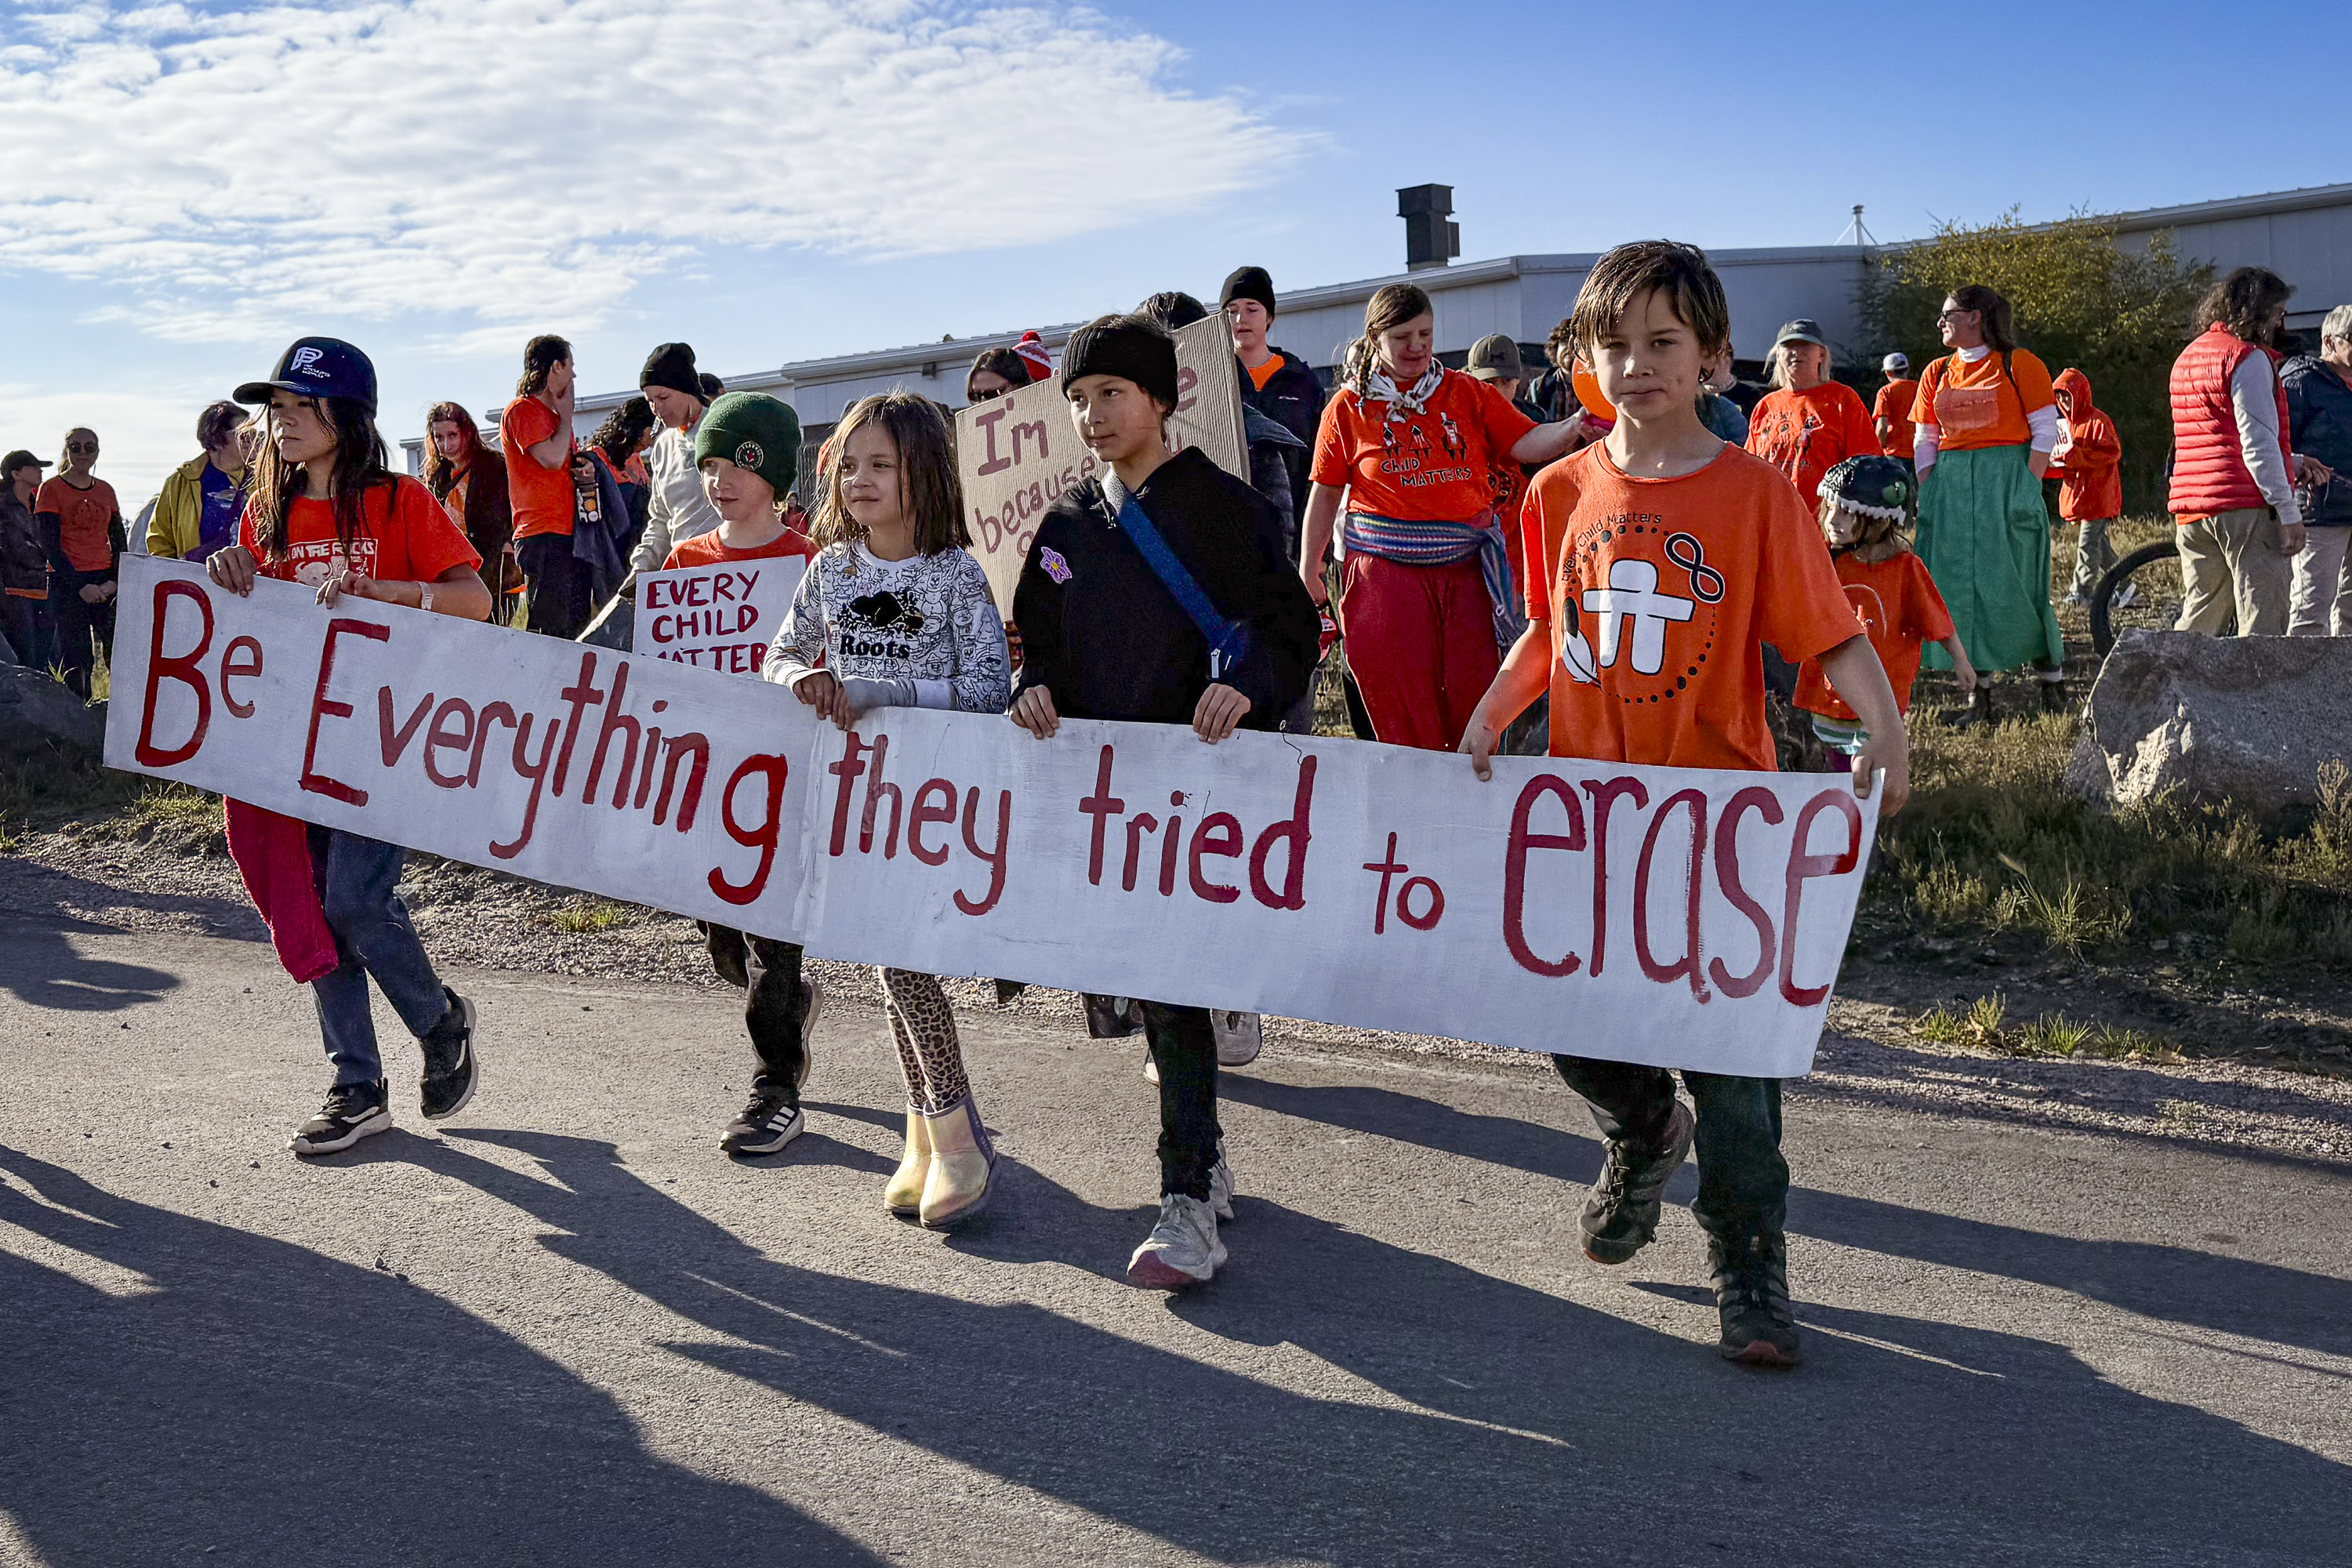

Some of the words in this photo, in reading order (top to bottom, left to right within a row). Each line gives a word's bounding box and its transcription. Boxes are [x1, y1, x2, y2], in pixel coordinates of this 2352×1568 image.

[975, 397, 1049, 477] I'm
[1400, 466, 1472, 487] MATTERS
[291, 546, 305, 560] ON
[305, 543, 330, 558] THE
[332, 541, 375, 555] RCKS
[1561, 551, 1582, 582] Every
[1577, 520, 1604, 547] Child
[1606, 511, 1662, 527] Matters
[646, 570, 760, 610] EVERY
[652, 604, 759, 643] CHILD
[839, 634, 910, 659] Roots
[135, 579, 263, 768] Be
[299, 618, 789, 906] Everything
[829, 731, 1011, 916] they
[1079, 744, 1318, 911] tried
[1362, 831, 1445, 935] to
[1503, 773, 1862, 1007] erase
